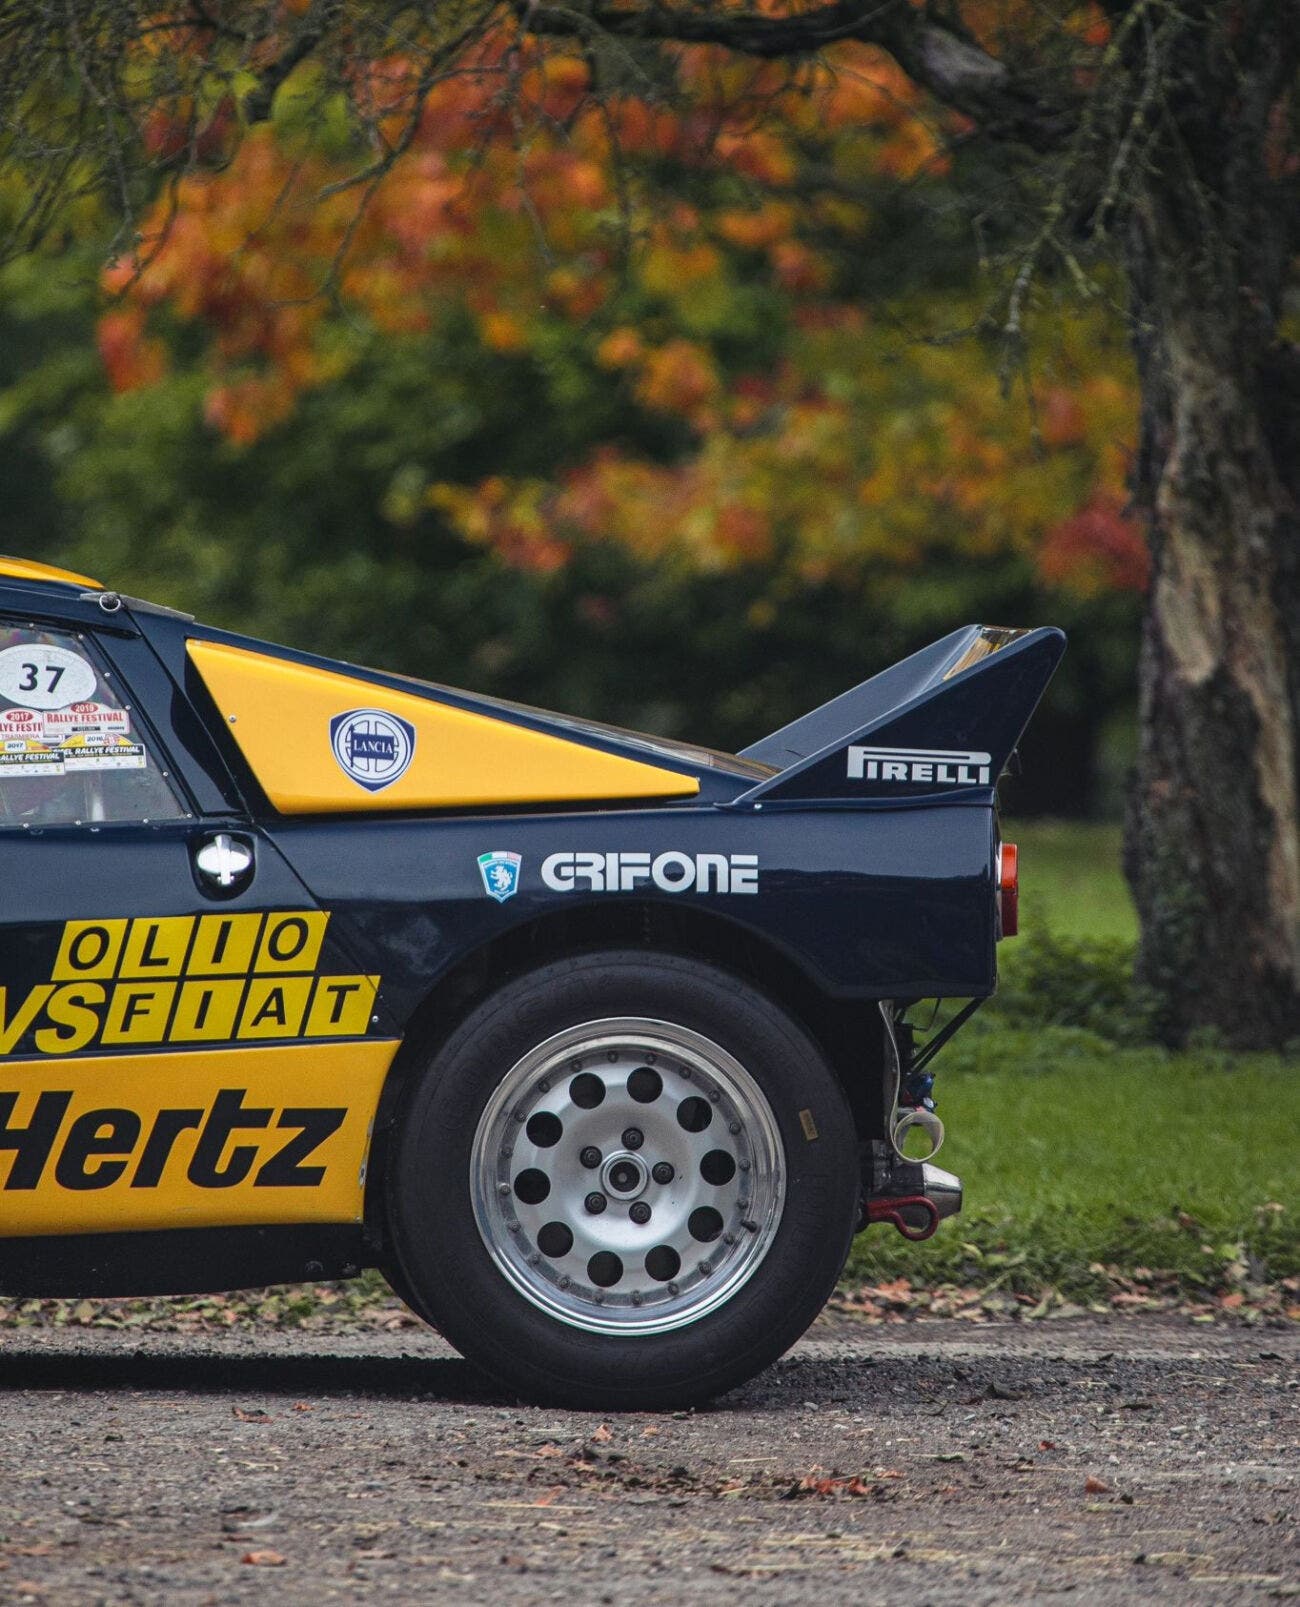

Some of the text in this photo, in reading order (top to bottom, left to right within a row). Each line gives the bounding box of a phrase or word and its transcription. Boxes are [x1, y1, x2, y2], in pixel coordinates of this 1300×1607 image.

[19, 663, 66, 693] 37
[10, 713, 29, 721] 2017
[16, 722, 43, 732] FESTI
[47, 712, 123, 723] RALLYE FESTIVAL
[25, 752, 60, 761] FESTIVAL
[75, 747, 105, 755] RALLYE
[105, 746, 140, 754] FESTIVAL
[353, 739, 393, 753] LANCIA
[847, 746, 991, 785] PIRELLI
[541, 851, 758, 894] GRIFONE
[68, 917, 309, 971] OLIO
[119, 983, 361, 1033] FIAT
[0, 1089, 348, 1190] Hertz
